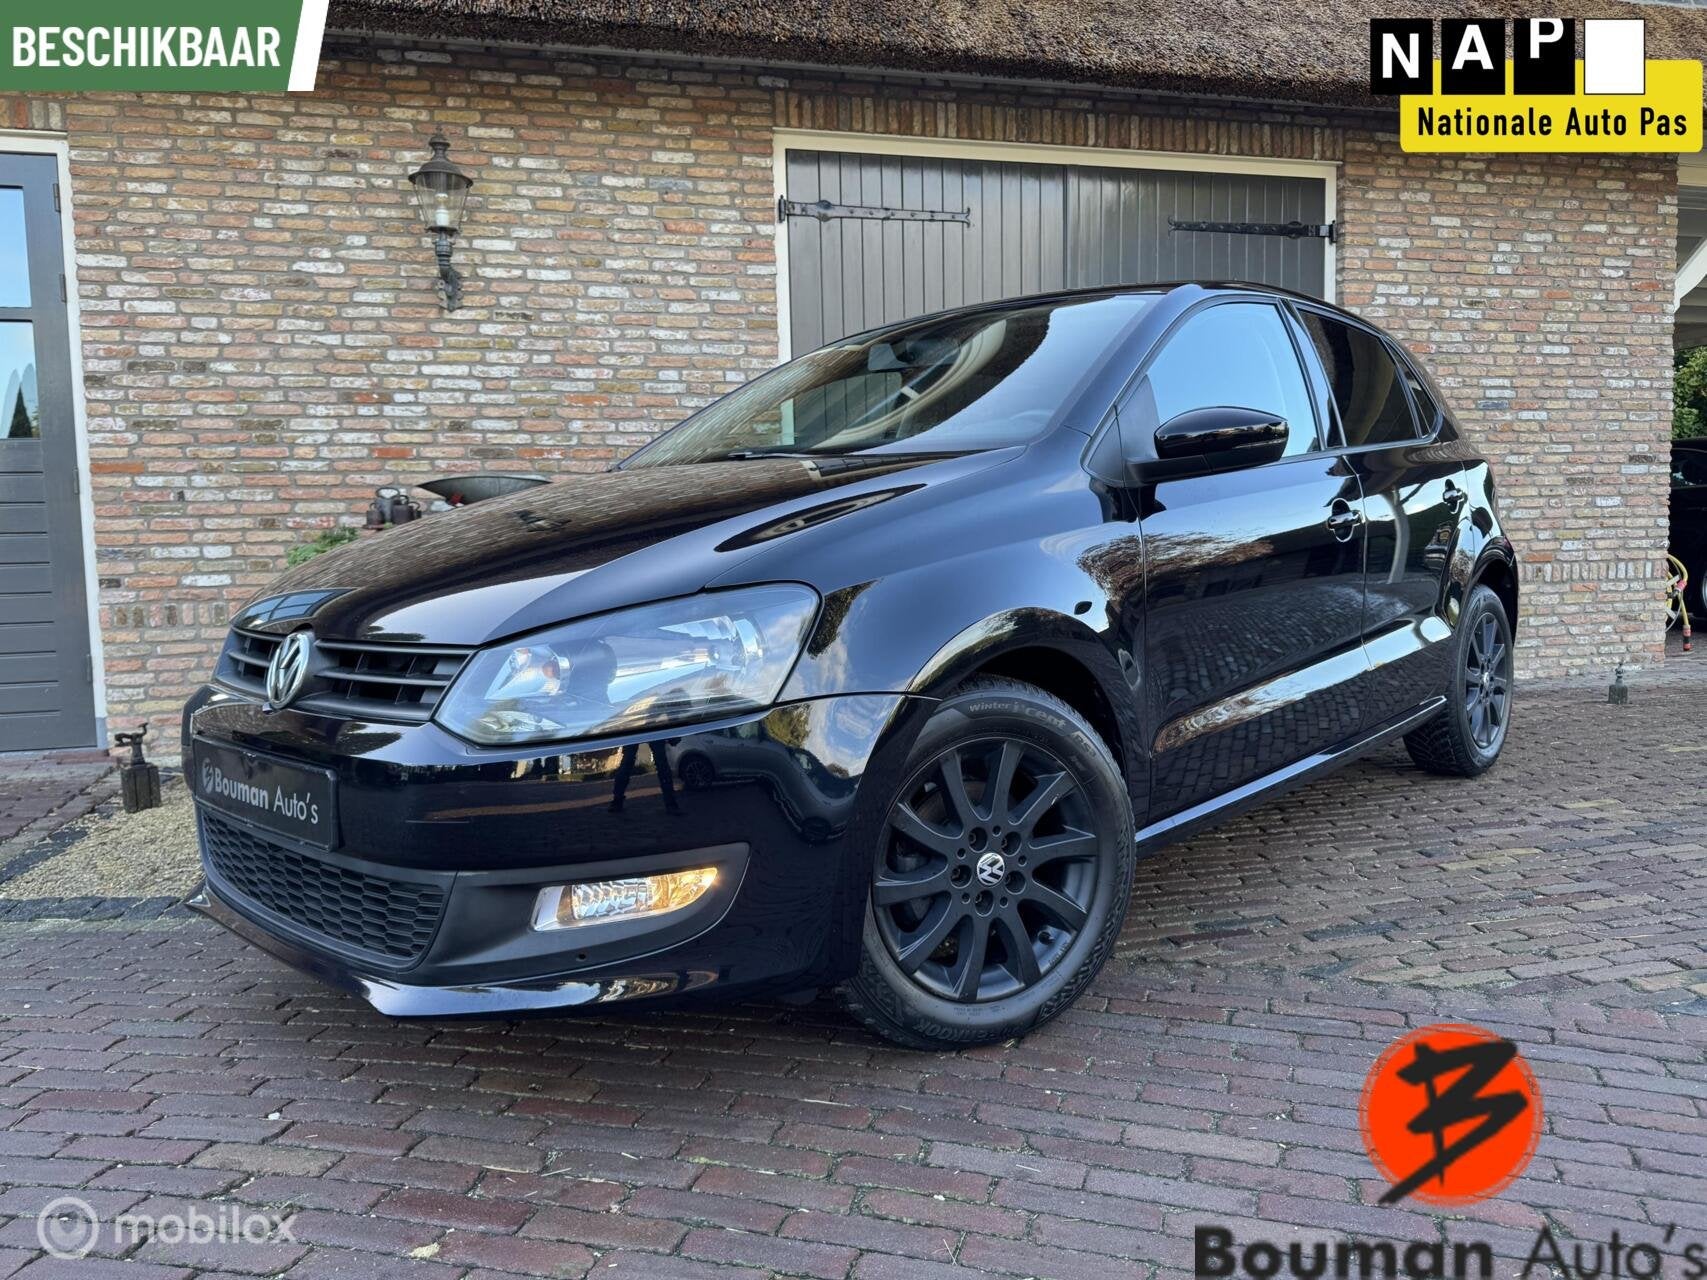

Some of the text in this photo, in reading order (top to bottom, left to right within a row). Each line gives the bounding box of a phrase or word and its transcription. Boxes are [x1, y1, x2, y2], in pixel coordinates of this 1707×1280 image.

[968, 701, 1011, 713] Winter
[214, 767, 269, 810] Bouman
[273, 786, 319, 825] Auto's
